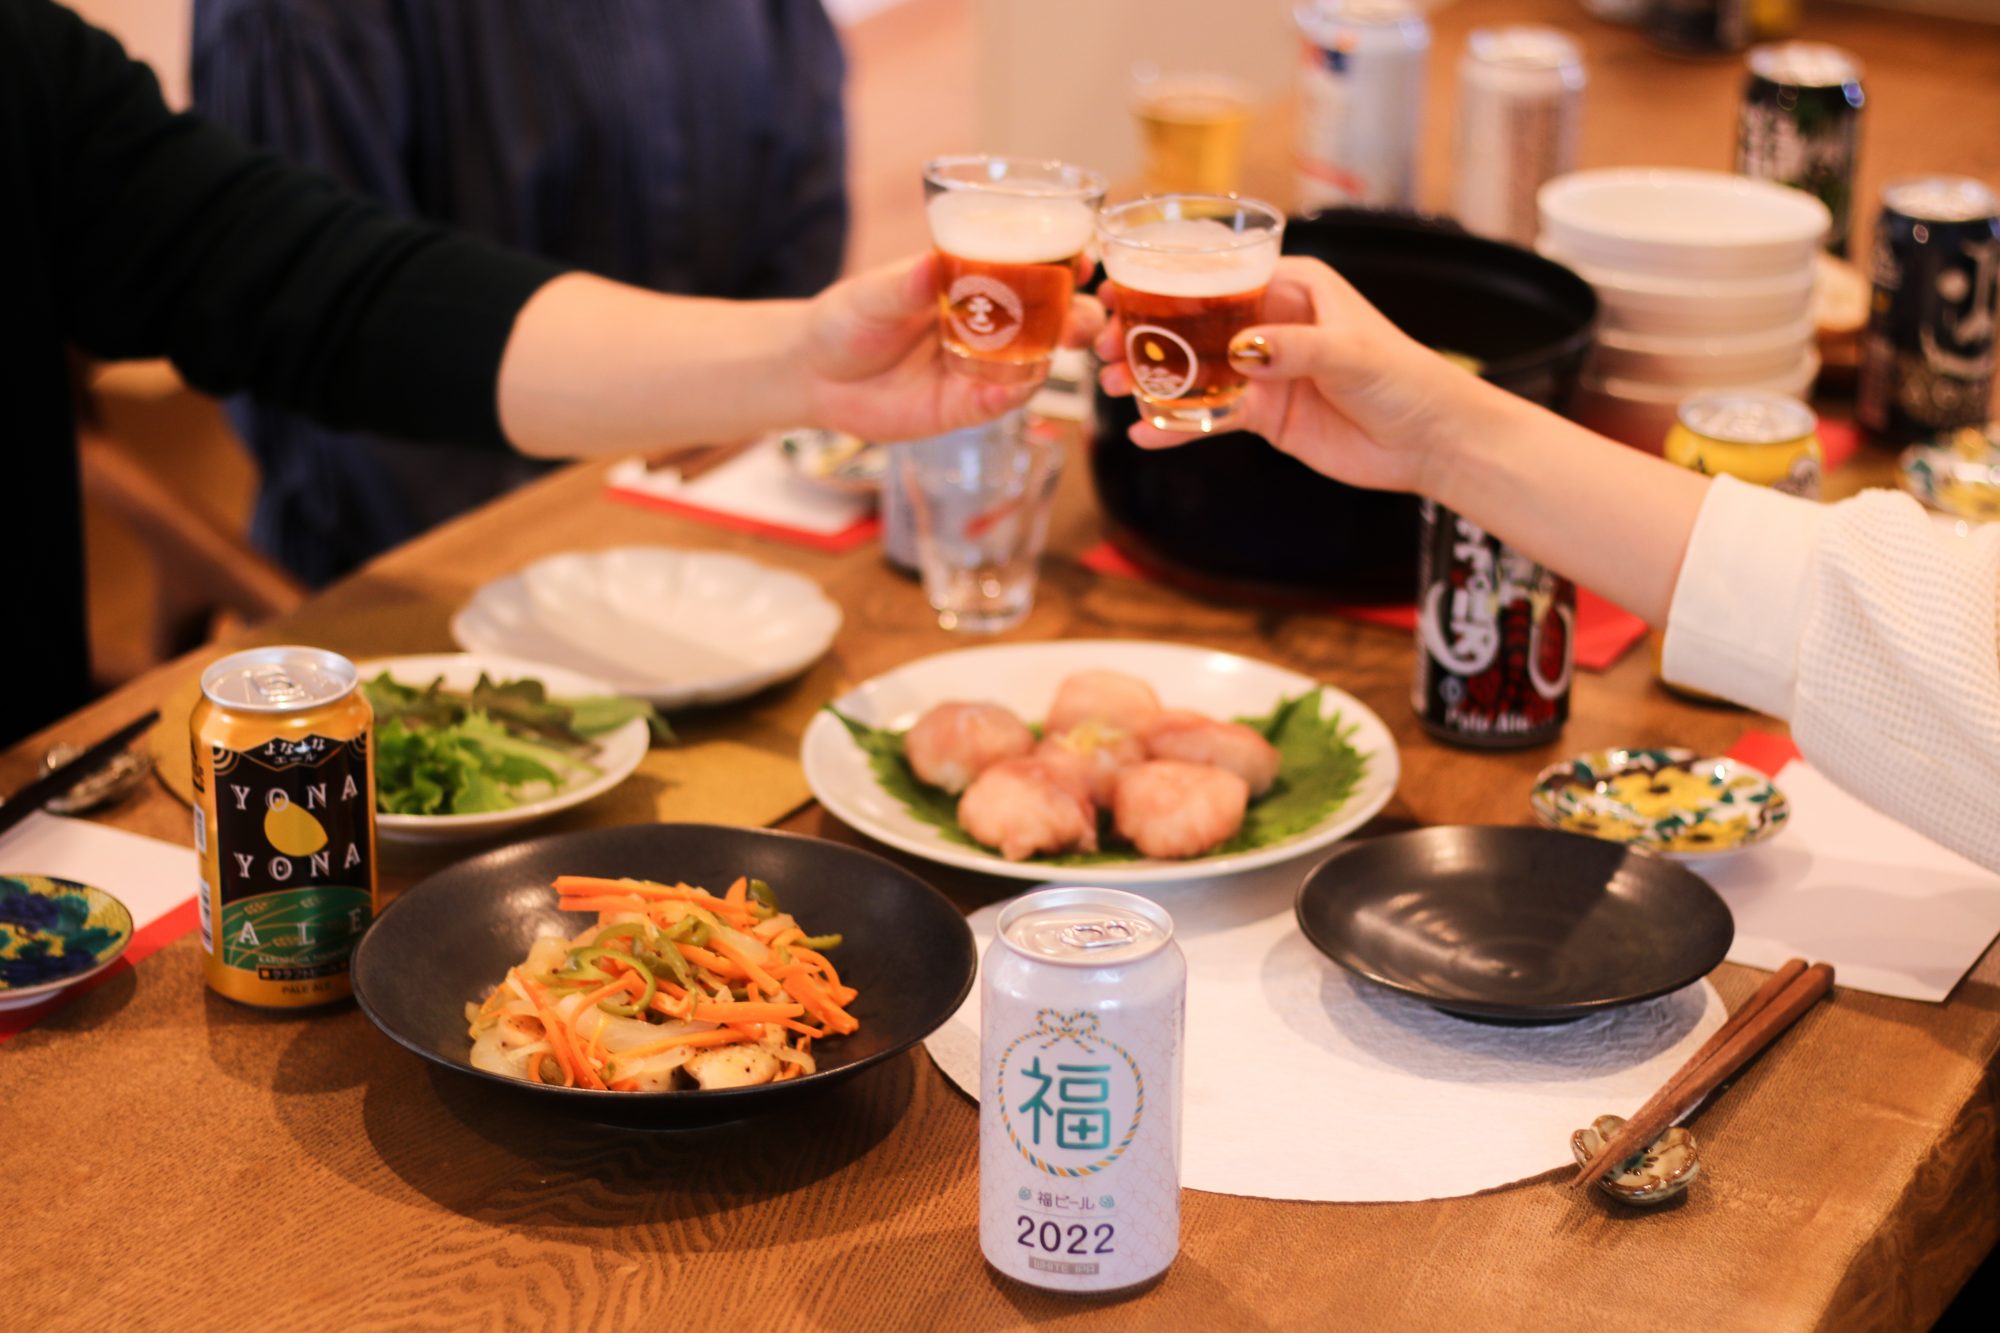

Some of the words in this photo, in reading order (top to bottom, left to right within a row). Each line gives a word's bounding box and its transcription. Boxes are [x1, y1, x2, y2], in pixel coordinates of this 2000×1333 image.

[231, 774, 359, 812] YONA
[234, 842, 361, 880] YONA
[239, 908, 363, 946] ALE
[1018, 1056, 1111, 1150] 福
[1037, 1191, 1096, 1210] 福ビール
[1017, 1215, 1115, 1254] 2022
